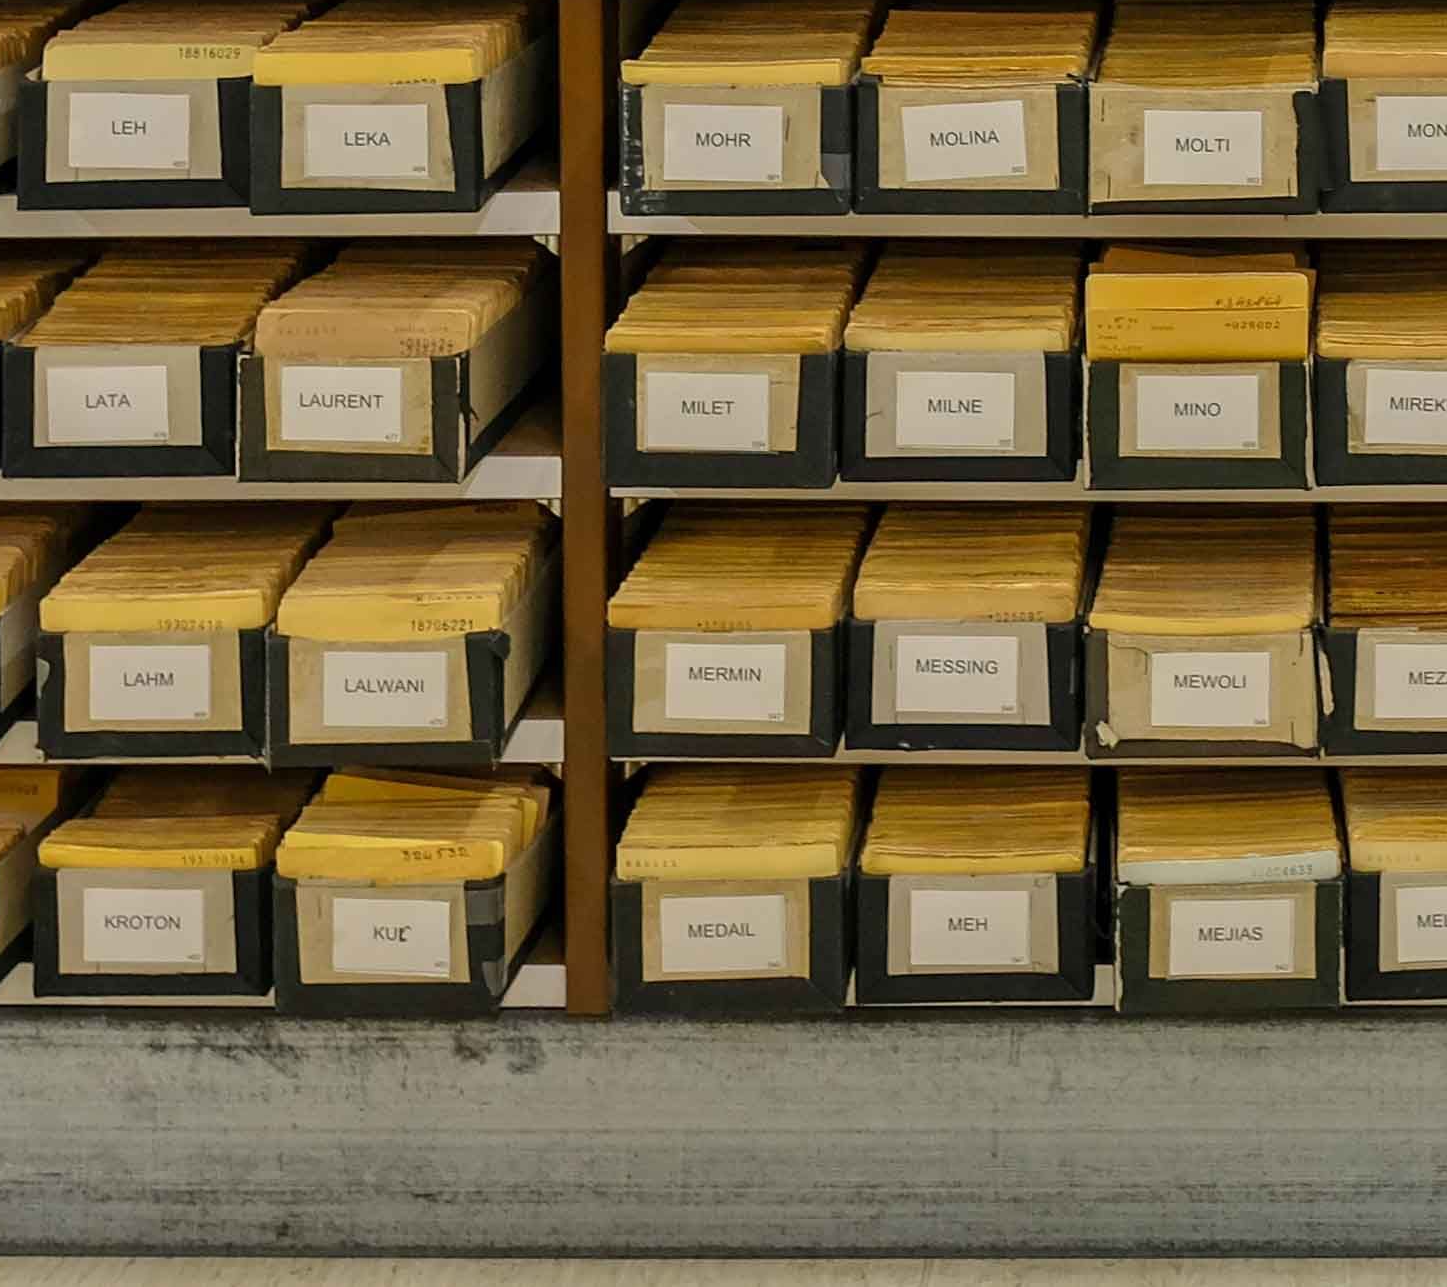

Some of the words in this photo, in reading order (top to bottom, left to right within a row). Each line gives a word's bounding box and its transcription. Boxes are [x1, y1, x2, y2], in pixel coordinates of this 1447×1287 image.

[111, 120, 147, 136] LEH
[344, 131, 391, 147] LEKA
[695, 132, 751, 148] MOHR
[929, 130, 1000, 148] MOLINA
[299, 392, 384, 409] LAURENT
[927, 398, 982, 414] MILNE
[1174, 402, 1222, 418] MINO
[688, 666, 762, 682] MERMIN
[915, 658, 999, 675] MESSING
[123, 671, 175, 688] LAHM
[344, 678, 425, 694] LALWANI
[1173, 674, 1247, 690] MEWOLI
[104, 914, 181, 931] KROTON
[947, 917, 988, 932] MEH
[1198, 926, 1264, 942] MEJIAS
